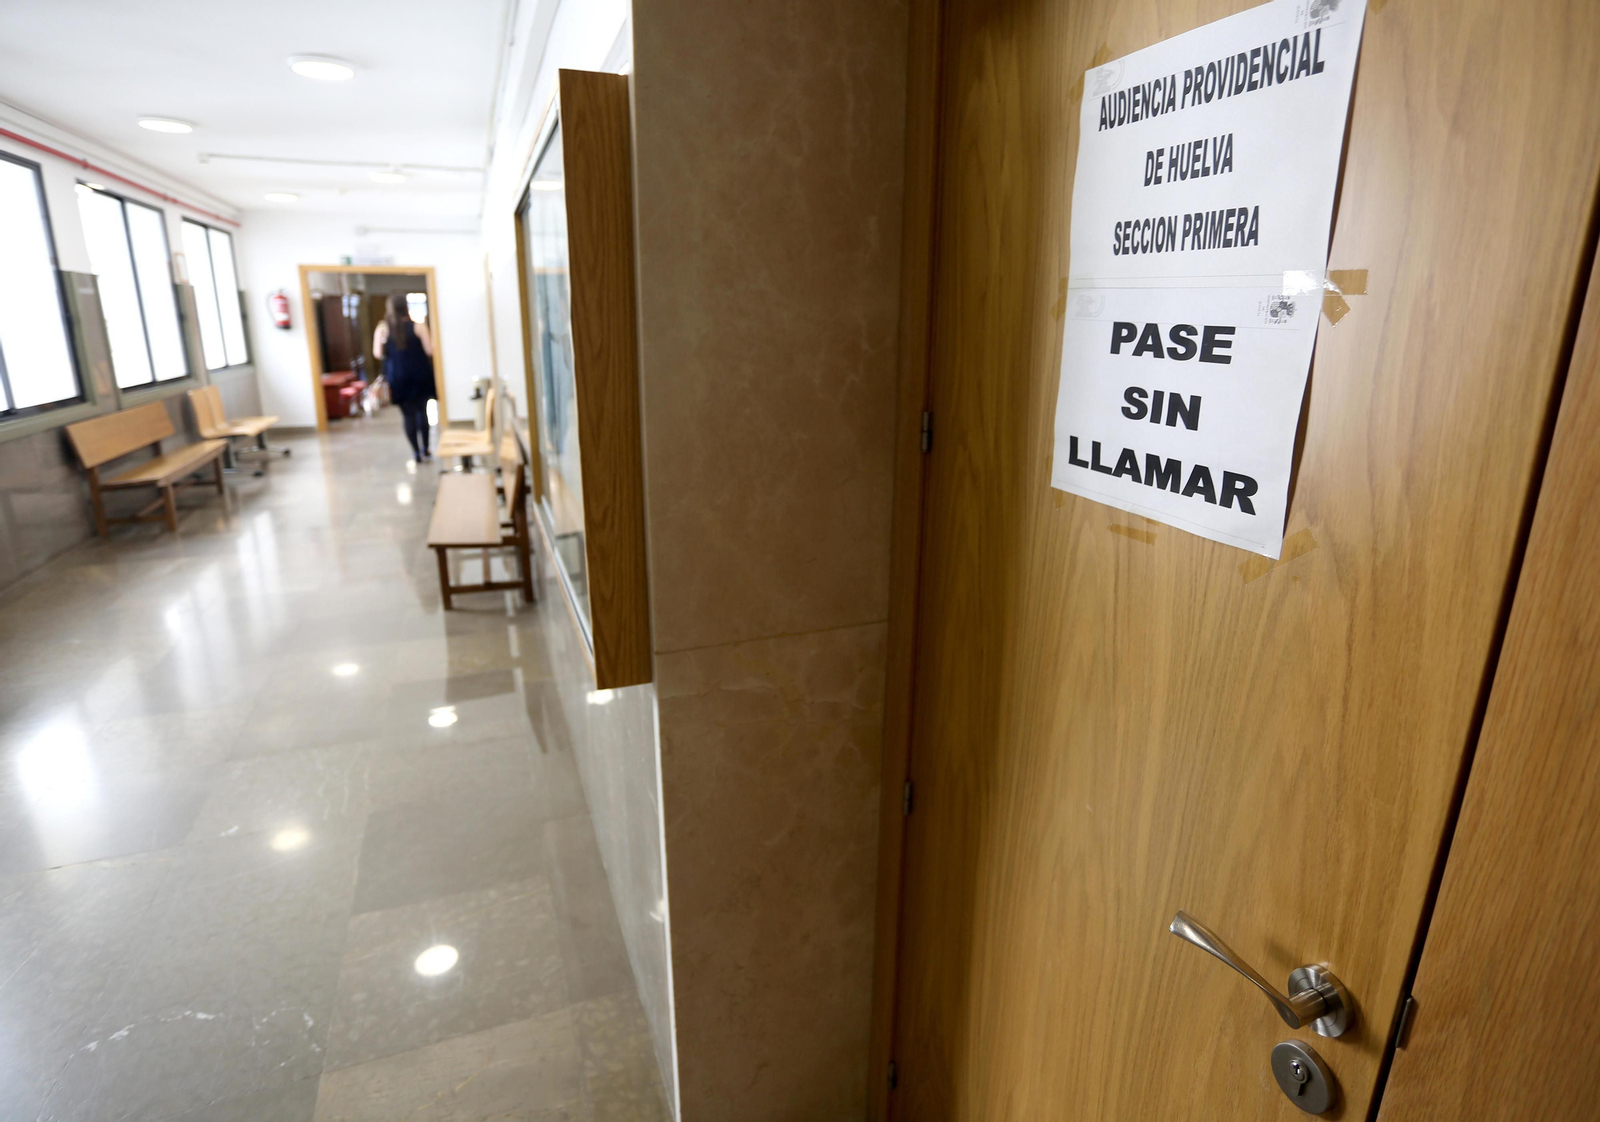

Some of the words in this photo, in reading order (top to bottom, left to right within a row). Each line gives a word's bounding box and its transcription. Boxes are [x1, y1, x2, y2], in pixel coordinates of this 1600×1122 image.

[1098, 74, 1177, 132] AUDIENCIA
[1180, 28, 1326, 110] PROVIDENCIAL
[1143, 148, 1165, 187] DE
[1167, 133, 1234, 183] HUELVA
[1113, 215, 1178, 256] SECCION
[1181, 205, 1260, 251] PRIMERA
[1109, 321, 1236, 364] PASE
[1121, 386, 1202, 431] SIN
[1068, 435, 1259, 516] LLAMAR
